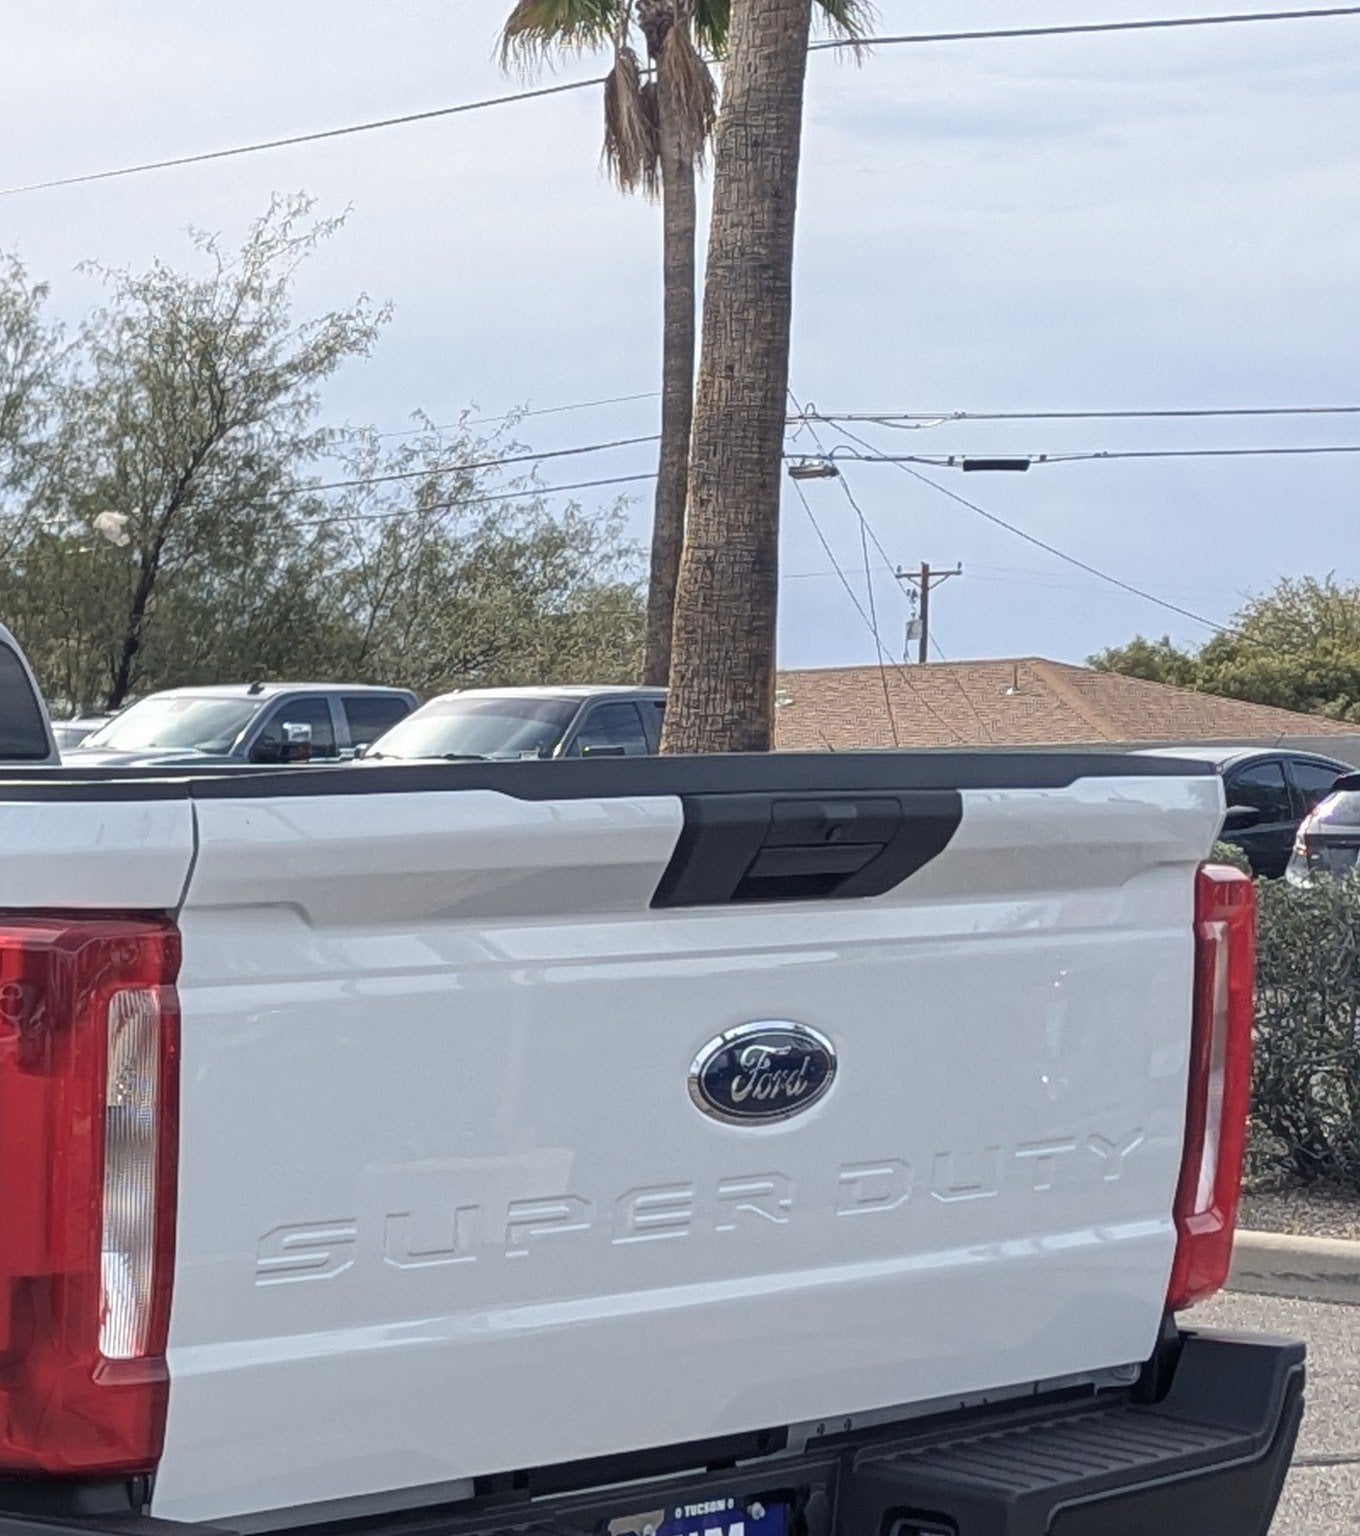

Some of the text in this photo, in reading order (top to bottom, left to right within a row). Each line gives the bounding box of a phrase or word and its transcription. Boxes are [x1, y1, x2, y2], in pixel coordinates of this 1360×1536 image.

[730, 1044, 812, 1104] Ford
[254, 1127, 1146, 1287] SUPER DUTY
[684, 1498, 726, 1518] TUCSON
